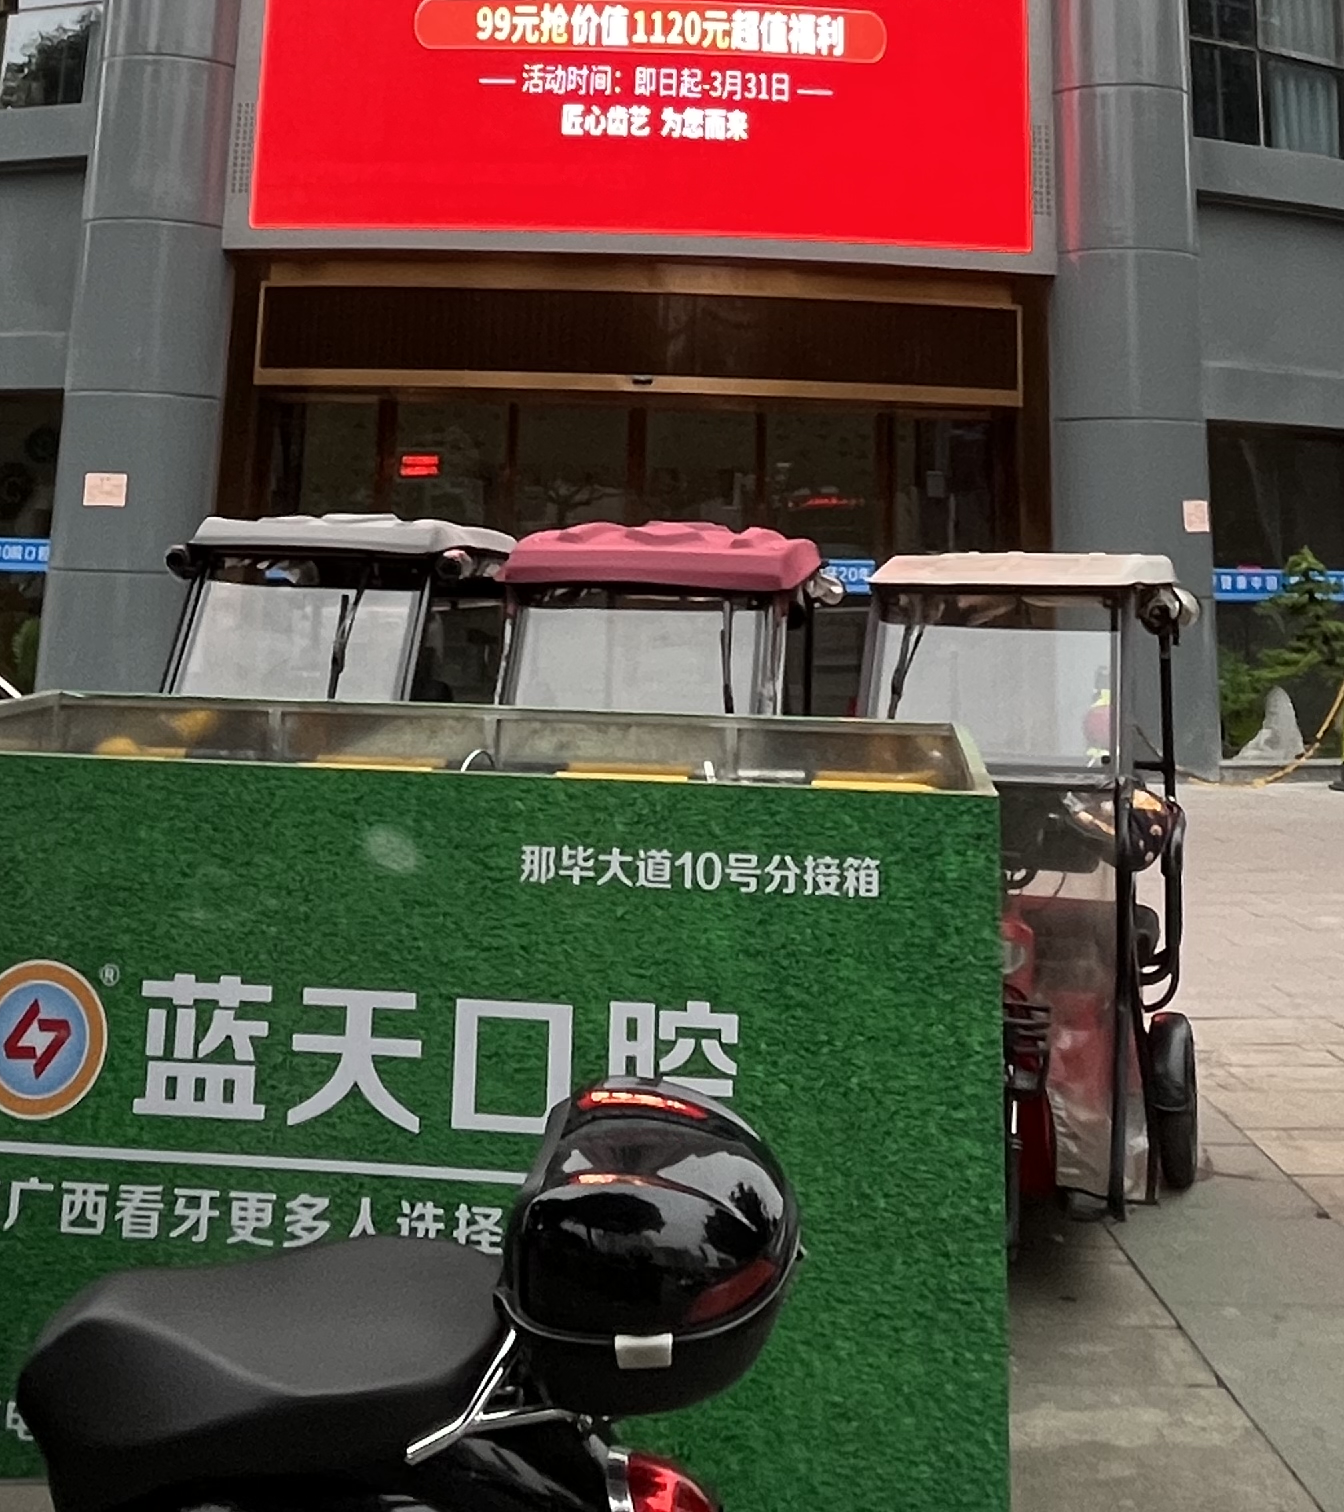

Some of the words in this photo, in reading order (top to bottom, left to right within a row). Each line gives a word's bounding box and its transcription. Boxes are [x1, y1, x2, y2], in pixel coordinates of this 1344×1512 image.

[475, 4, 845, 56] 99元抢价值1120元超值福利
[660, 106, 749, 140] 为您而来
[519, 843, 881, 899] 那毕大道10号分接箱
